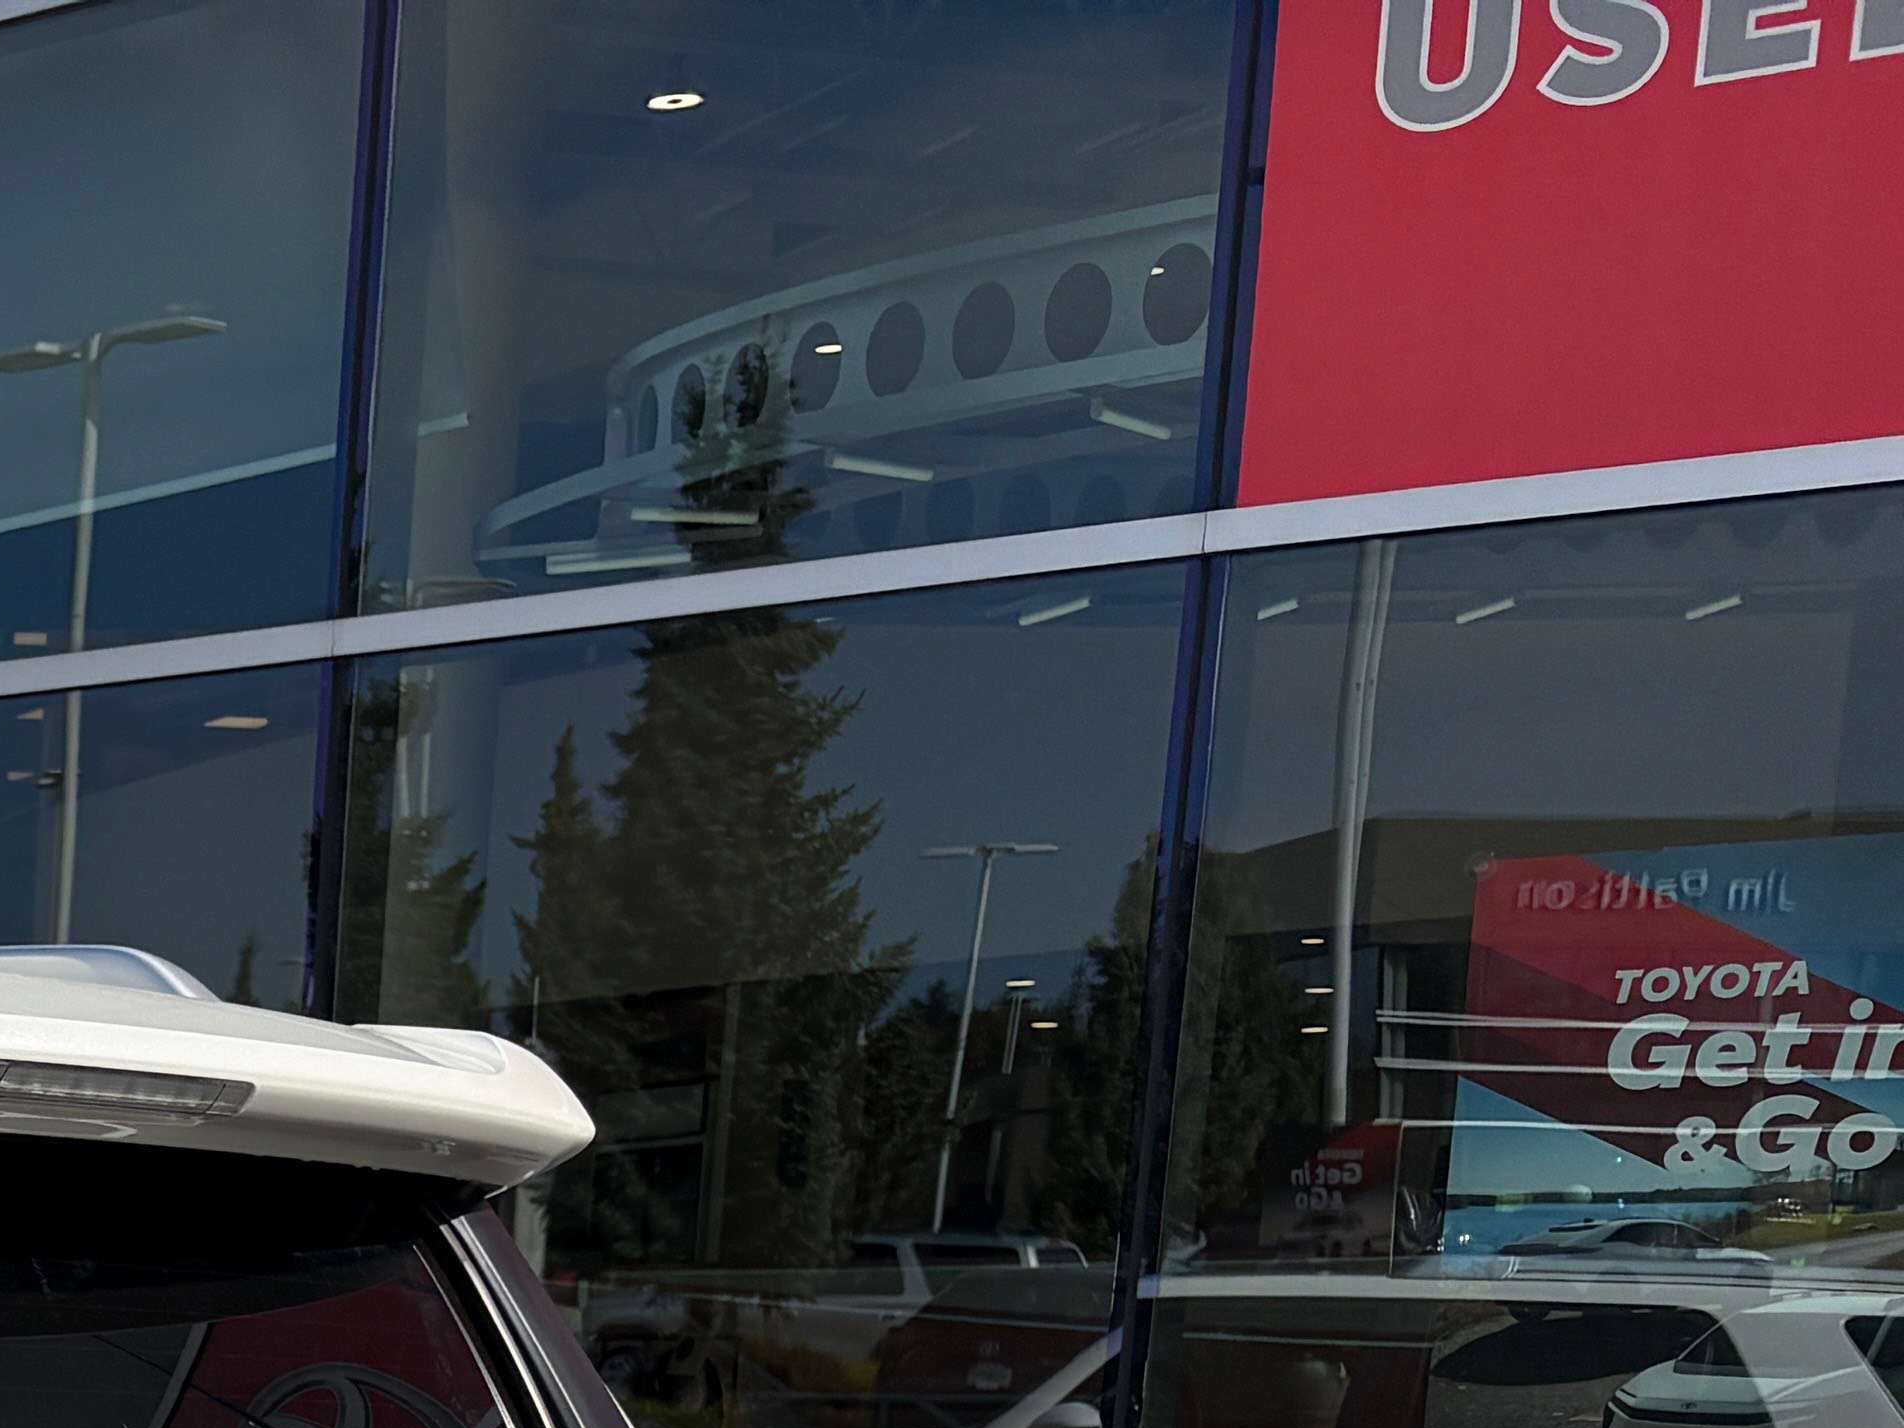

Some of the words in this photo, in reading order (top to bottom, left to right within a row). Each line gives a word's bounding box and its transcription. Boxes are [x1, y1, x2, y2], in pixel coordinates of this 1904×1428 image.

[1375, 0, 1904, 133] USE
[1615, 960, 1810, 1005] TOYOTA
[1607, 1011, 1812, 1091] Get
